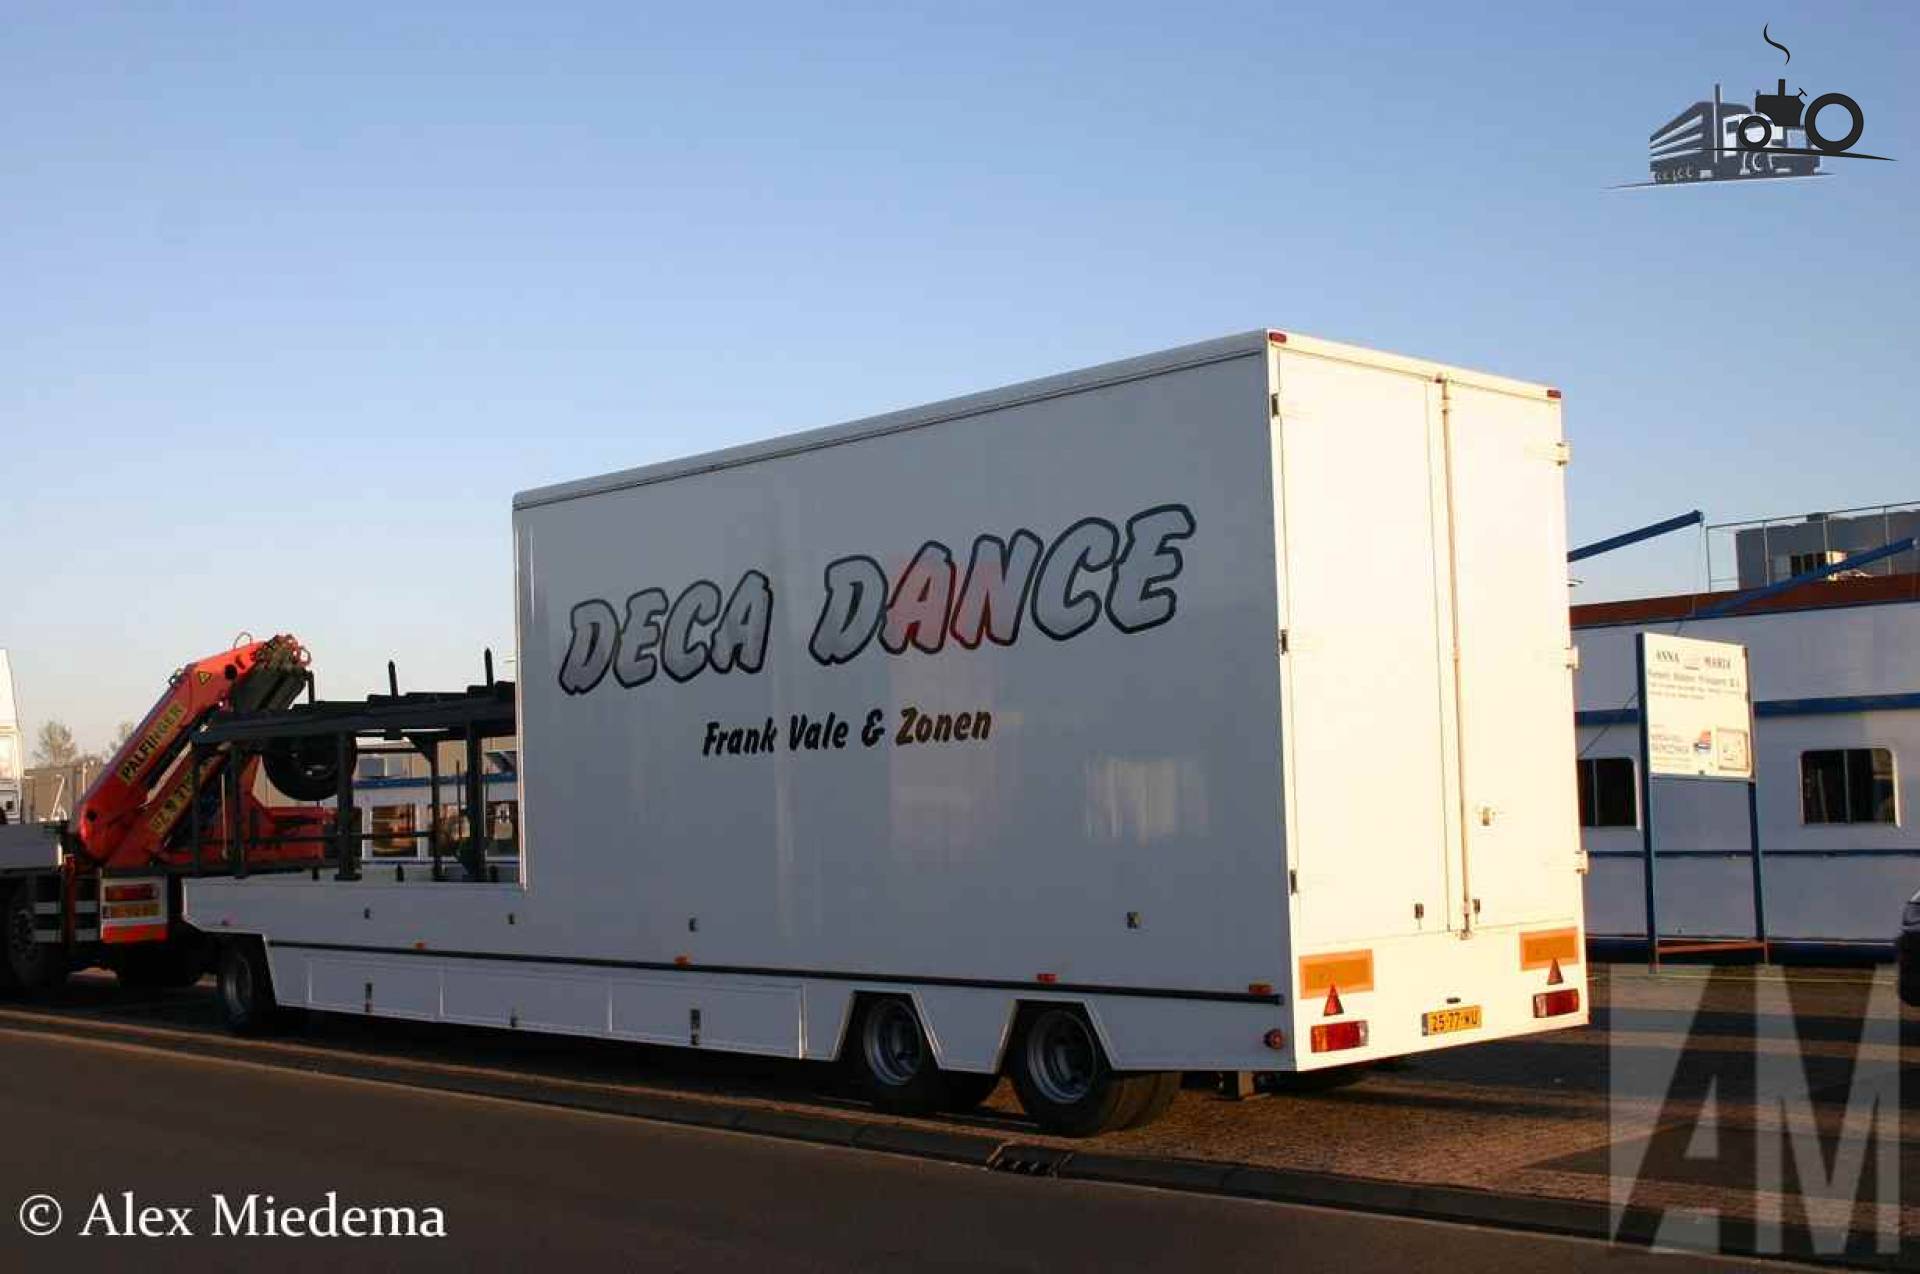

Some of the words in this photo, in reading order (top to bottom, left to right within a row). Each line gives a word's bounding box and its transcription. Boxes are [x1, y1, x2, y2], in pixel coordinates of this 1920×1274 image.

[558, 569, 773, 695] DECA
[808, 504, 1196, 666] DANCE
[121, 703, 185, 783] PALFINGER
[702, 722, 777, 757] Frank
[788, 713, 849, 751] Vale
[861, 709, 886, 748] &
[897, 708, 992, 746] Zonen
